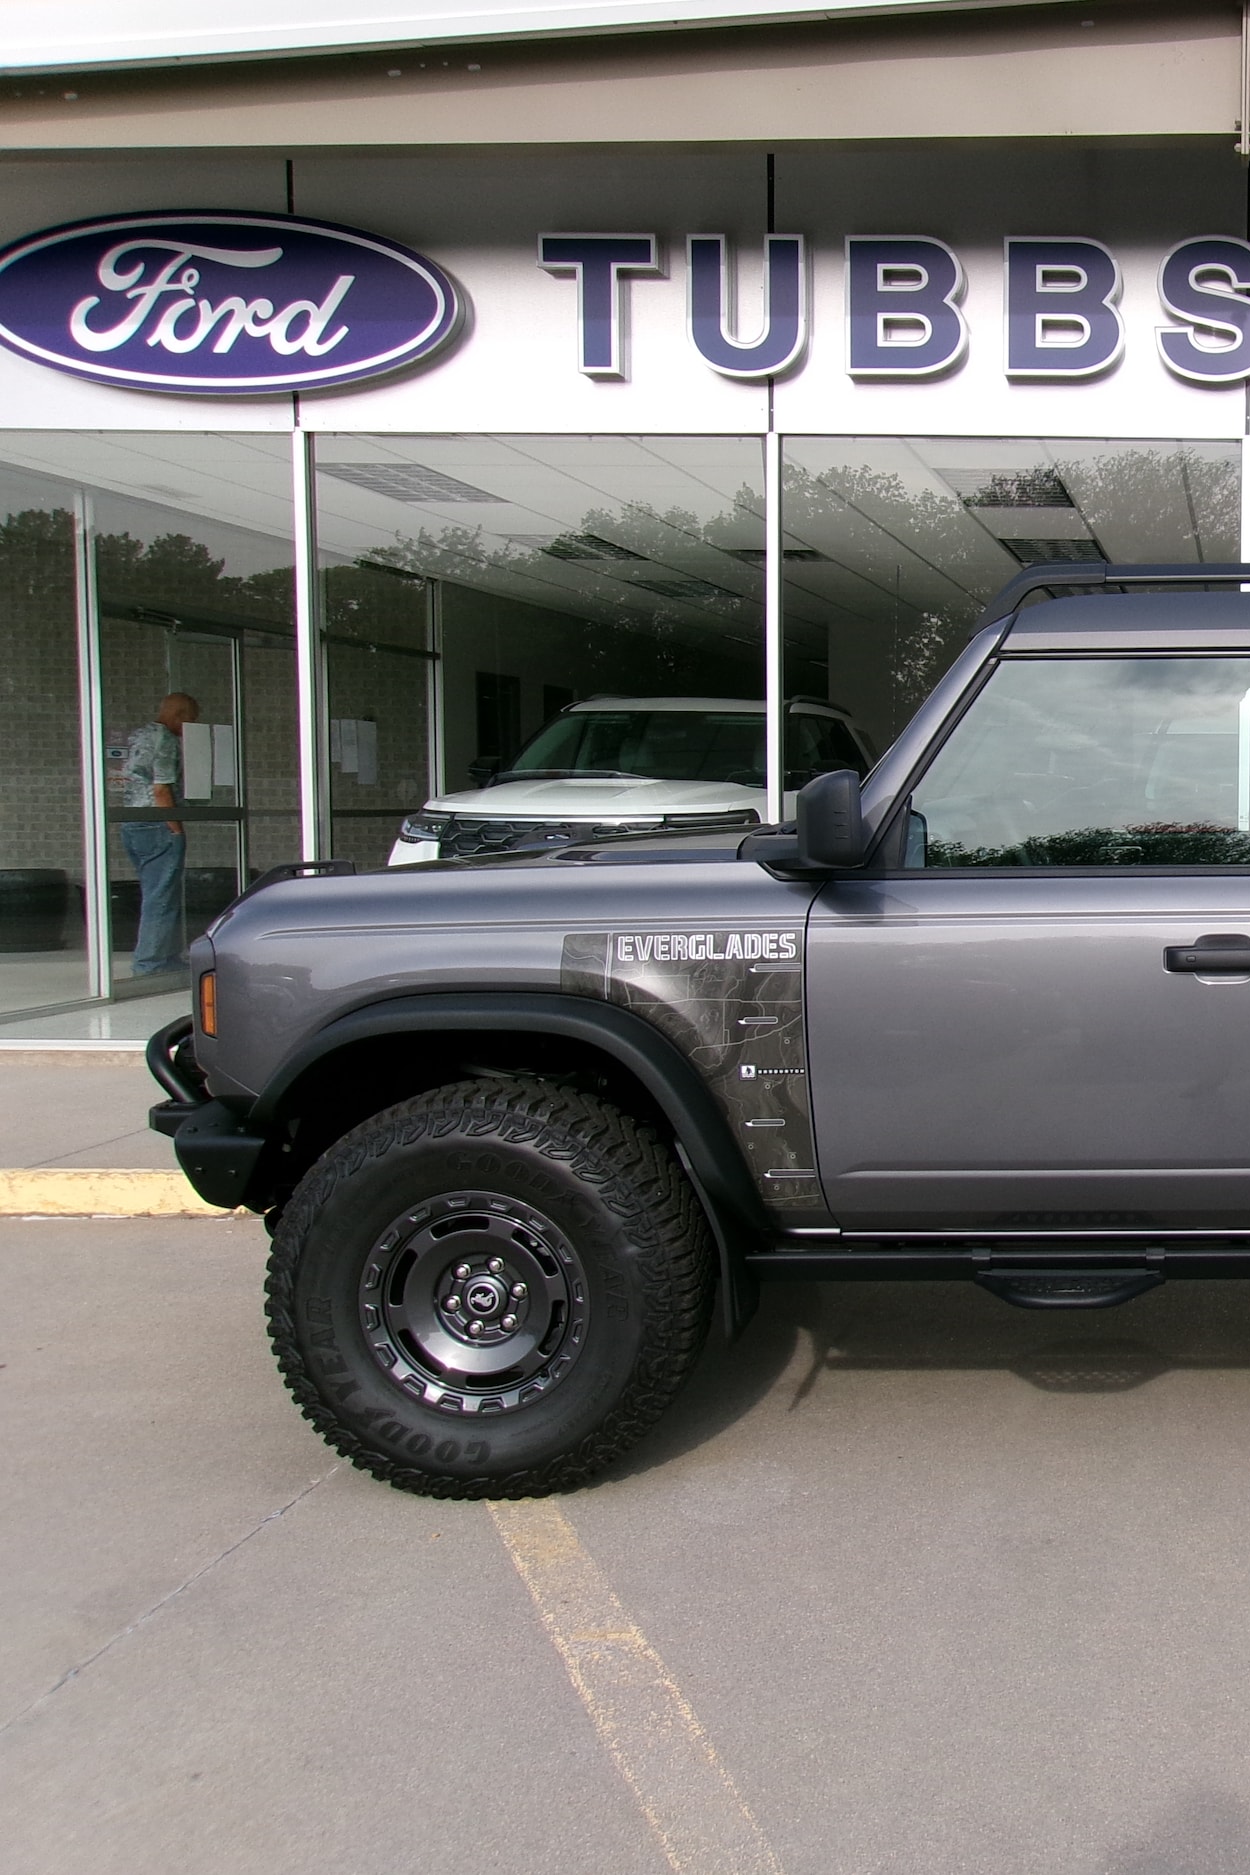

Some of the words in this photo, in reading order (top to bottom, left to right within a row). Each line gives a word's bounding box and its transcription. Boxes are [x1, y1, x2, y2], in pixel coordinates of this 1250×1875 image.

[70, 238, 356, 357] Ford
[616, 932, 797, 962] EVERGLADES
[303, 1296, 492, 1467] GOODYEAR
